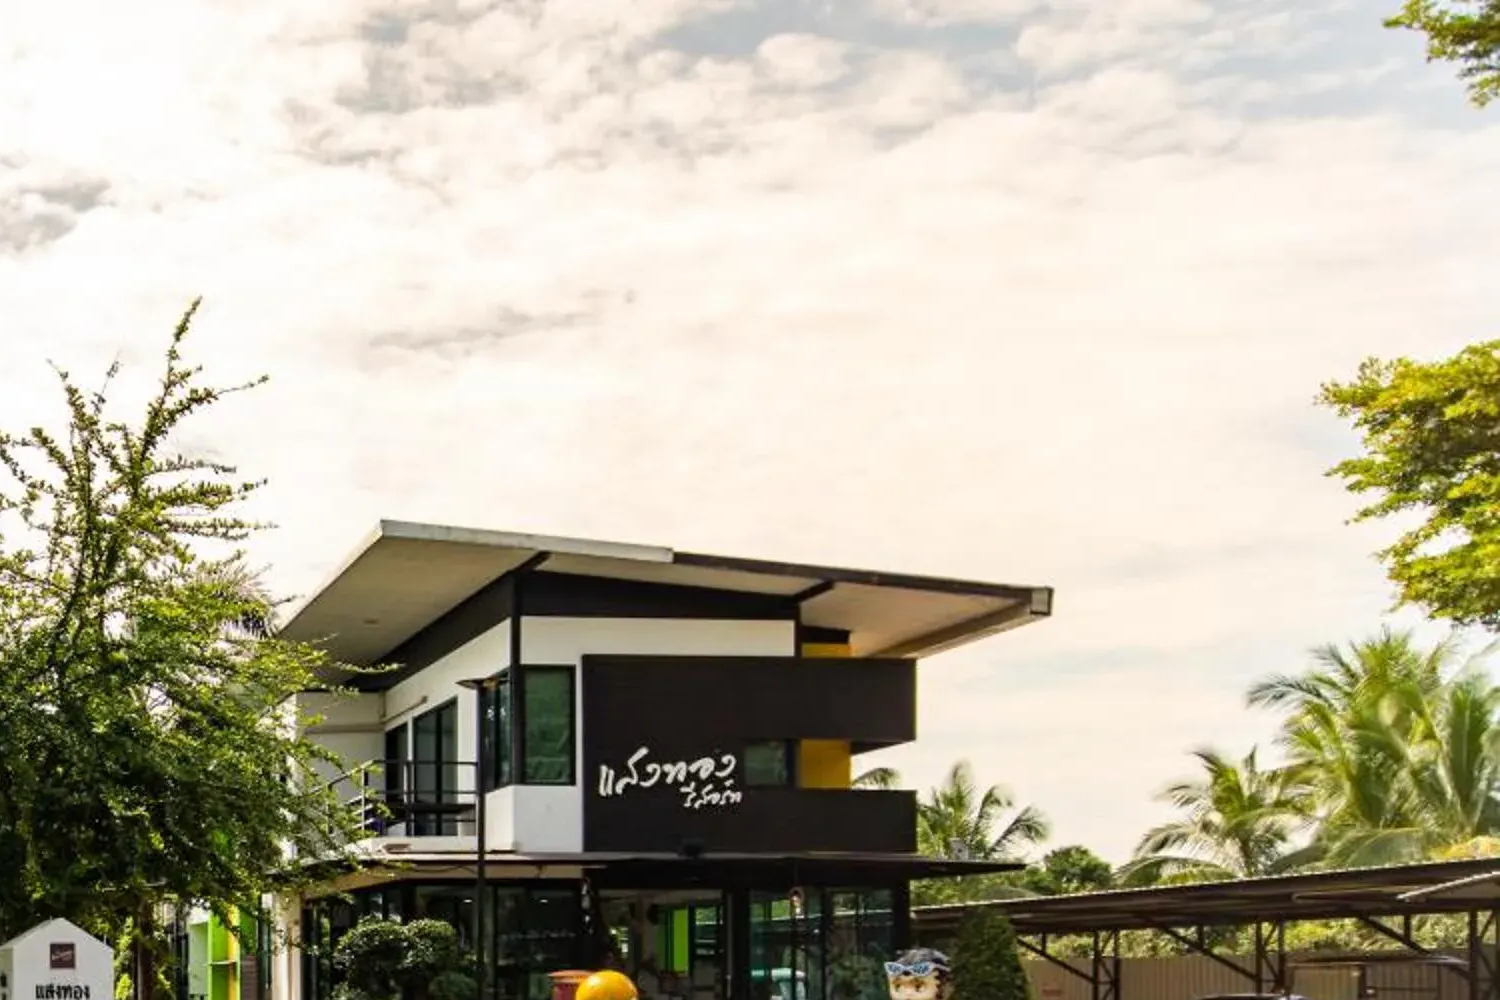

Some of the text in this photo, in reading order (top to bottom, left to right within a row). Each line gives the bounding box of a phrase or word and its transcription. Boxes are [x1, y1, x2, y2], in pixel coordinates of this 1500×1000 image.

[599, 746, 737, 796] แสงทอง
[35, 983, 90, 1000] แสงทอง
